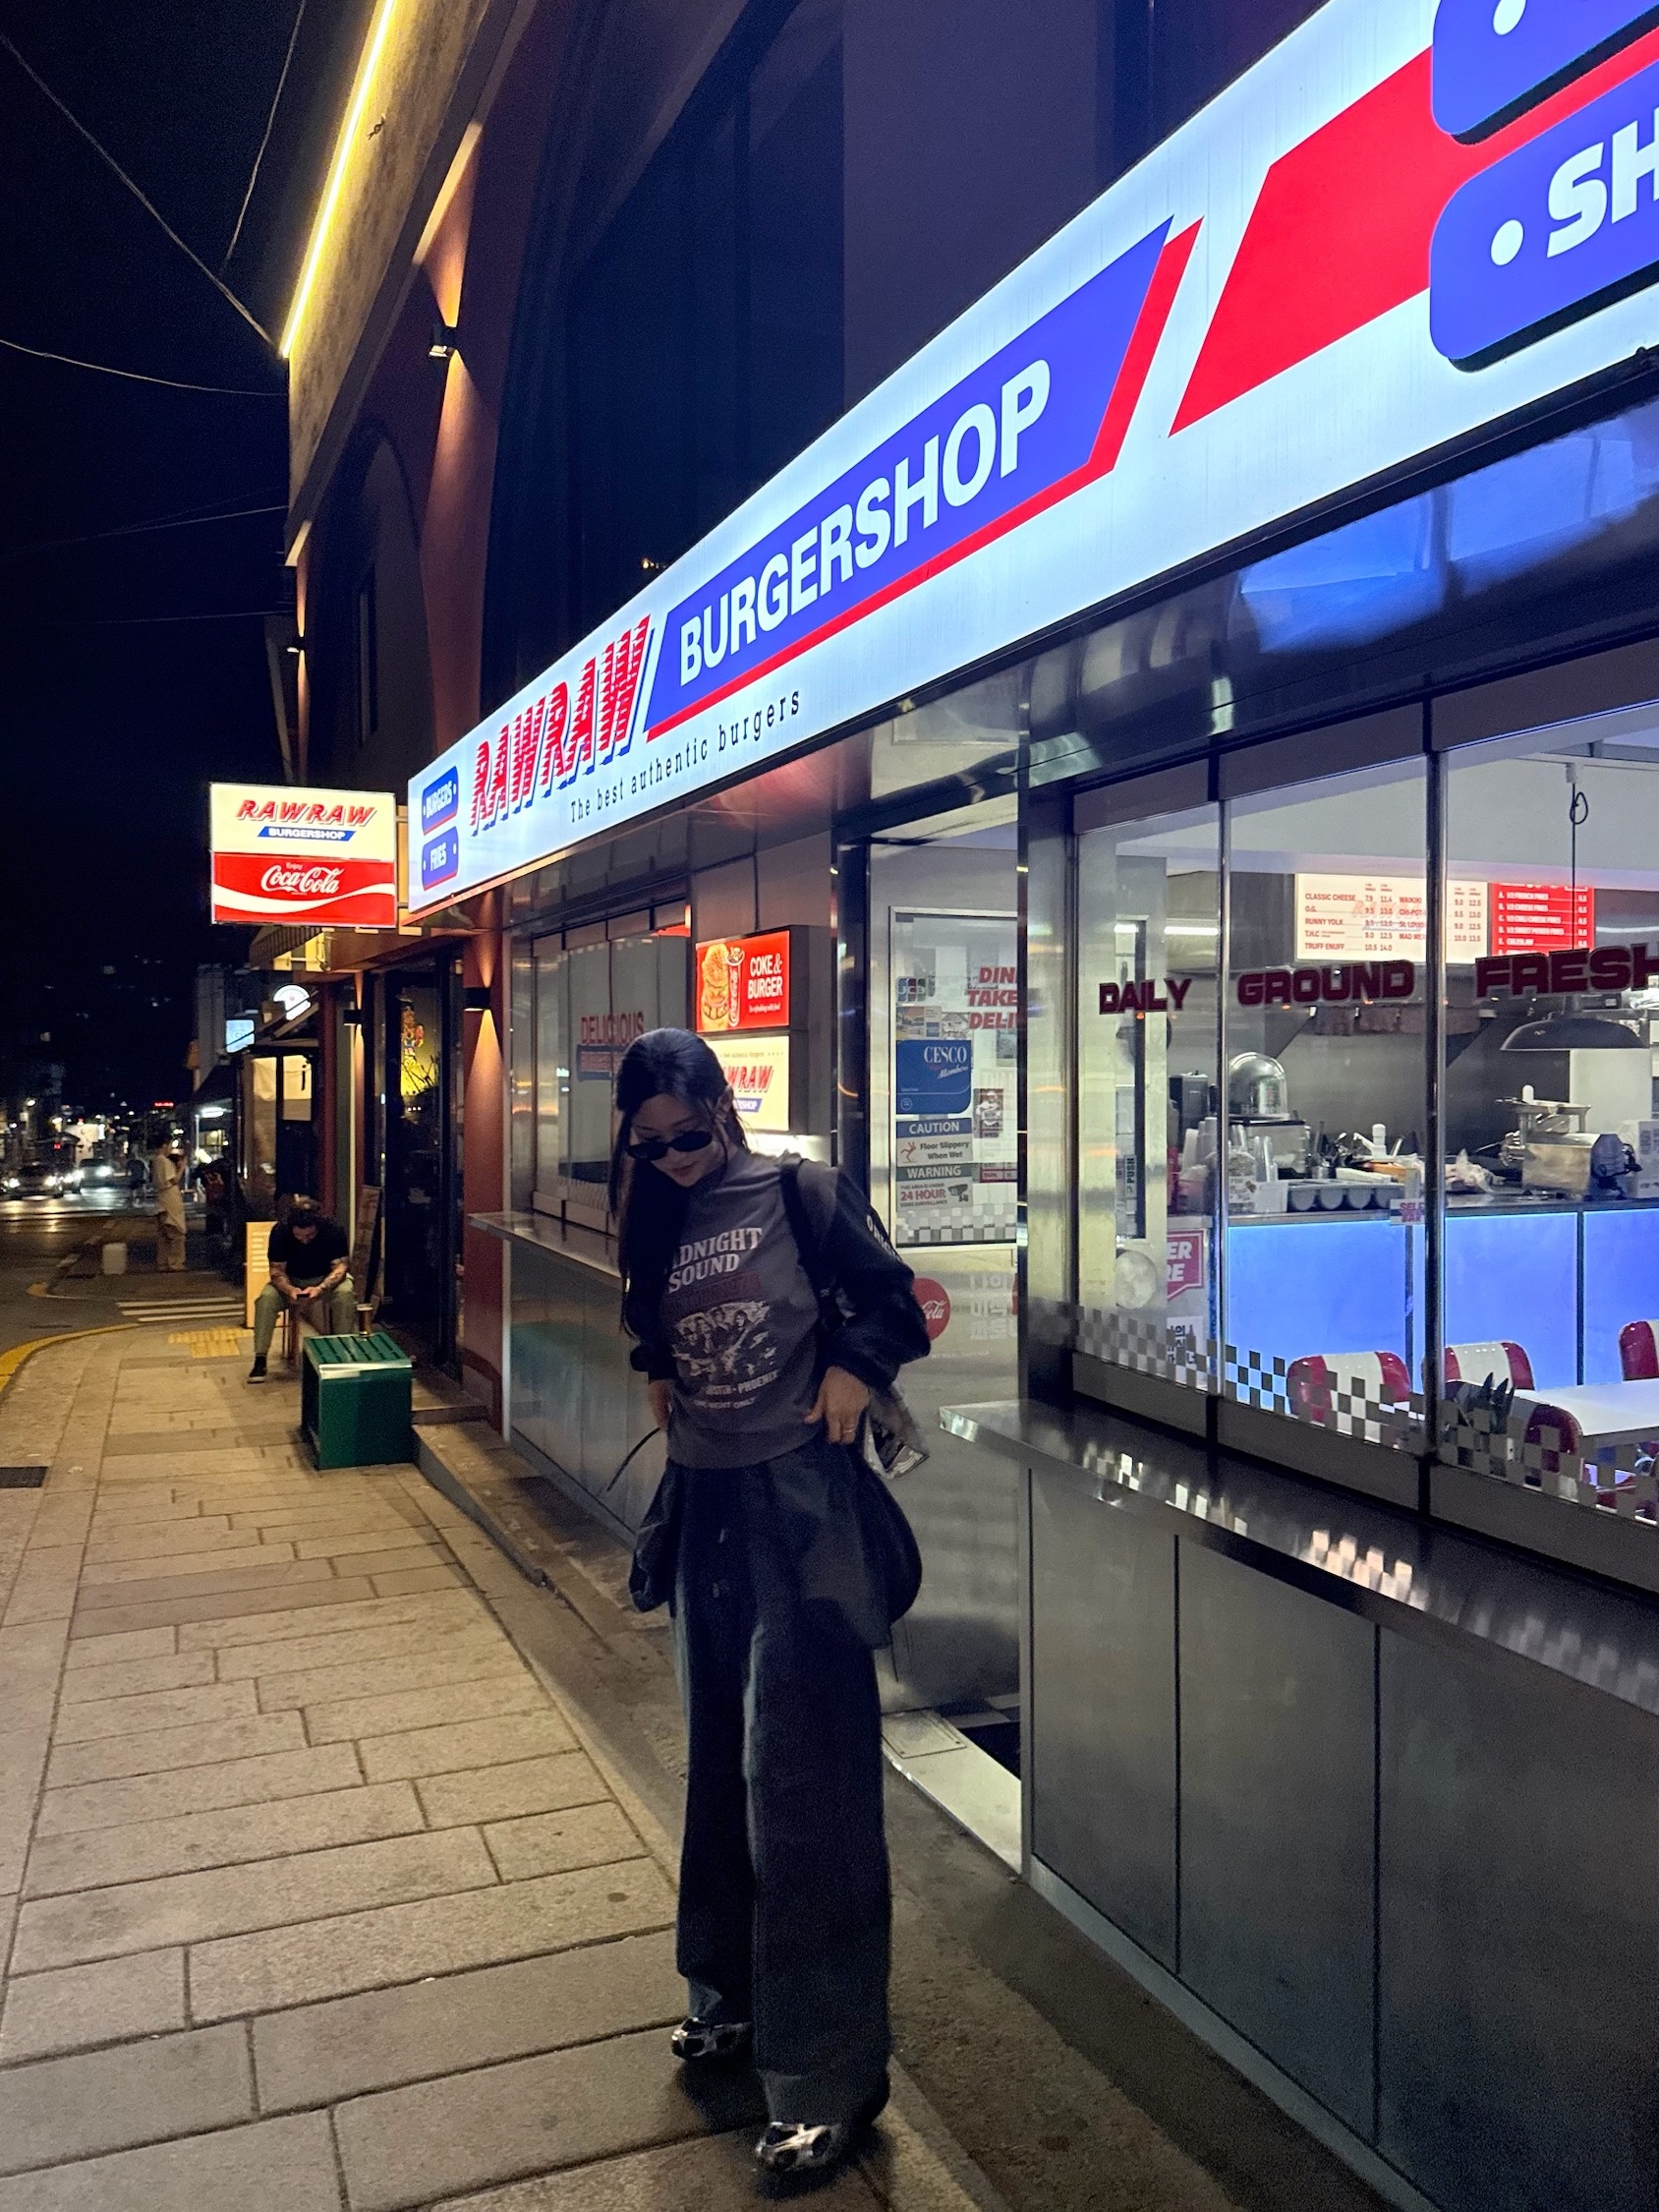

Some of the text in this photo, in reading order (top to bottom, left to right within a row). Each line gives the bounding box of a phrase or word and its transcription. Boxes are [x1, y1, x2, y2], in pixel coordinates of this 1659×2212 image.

[680, 359, 1051, 687] BURGERSHOP
[470, 613, 655, 838] RAWRAW
[571, 690, 800, 823] The best authentic burgers
[236, 799, 378, 828] RAWRAW
[426, 781, 452, 818] BURGERS
[268, 828, 346, 841] BURGERSHOP
[429, 842, 446, 872] FRIES
[260, 863, 345, 894] Coca-Cola
[750, 953, 783, 977] COKE &
[979, 966, 1016, 983] DIN
[1475, 942, 1659, 999] FRESH
[748, 975, 783, 999] BURGER
[1099, 976, 1192, 1015] DAILY
[1236, 960, 1415, 1007] GROUND
[581, 1012, 644, 1045] DELICIOUS
[969, 1012, 1017, 1029] DELI
[924, 1045, 967, 1064] CESCO
[725, 1065, 774, 1092] WRAW
[909, 1122, 960, 1135] CAUTION
[920, 1140, 970, 1151] Floor Slippery
[927, 1150, 963, 1160] When Wet
[906, 1166, 962, 1180] WARNING
[900, 1188, 945, 1201] 24 HOUR
[670, 1227, 763, 1269] DNIGHT
[668, 1253, 741, 1294] SOUND
